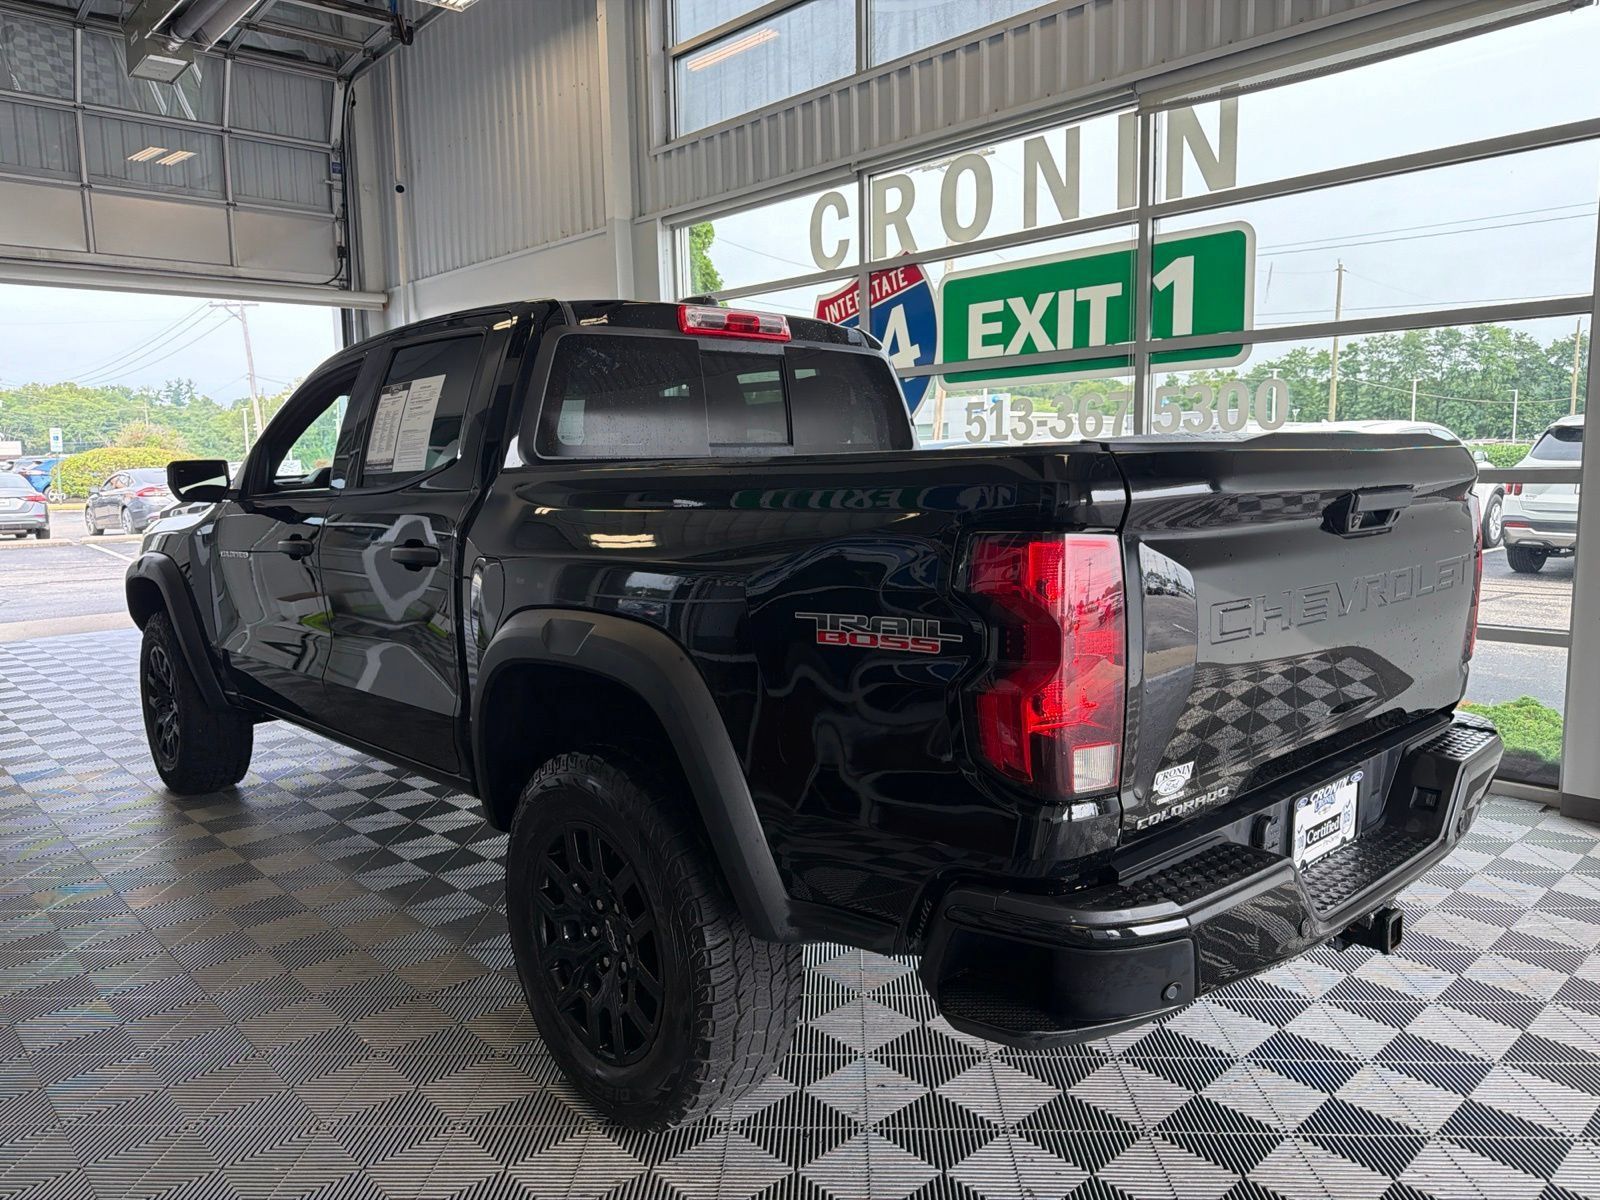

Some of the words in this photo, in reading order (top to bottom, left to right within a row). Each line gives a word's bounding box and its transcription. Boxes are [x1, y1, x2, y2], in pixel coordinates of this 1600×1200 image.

[809, 84, 1240, 272] CRONIN
[825, 266, 908, 323] INTERTATE
[967, 282, 1122, 360] EXIT
[1152, 255, 1195, 337] 1
[1210, 553, 1471, 645] CHEVROLET
[795, 612, 963, 643] TRAIL
[816, 630, 941, 655] BOSS
[1155, 762, 1194, 787] CRONIN
[1137, 785, 1230, 831] COLORADO
[1306, 815, 1341, 845] Certified
